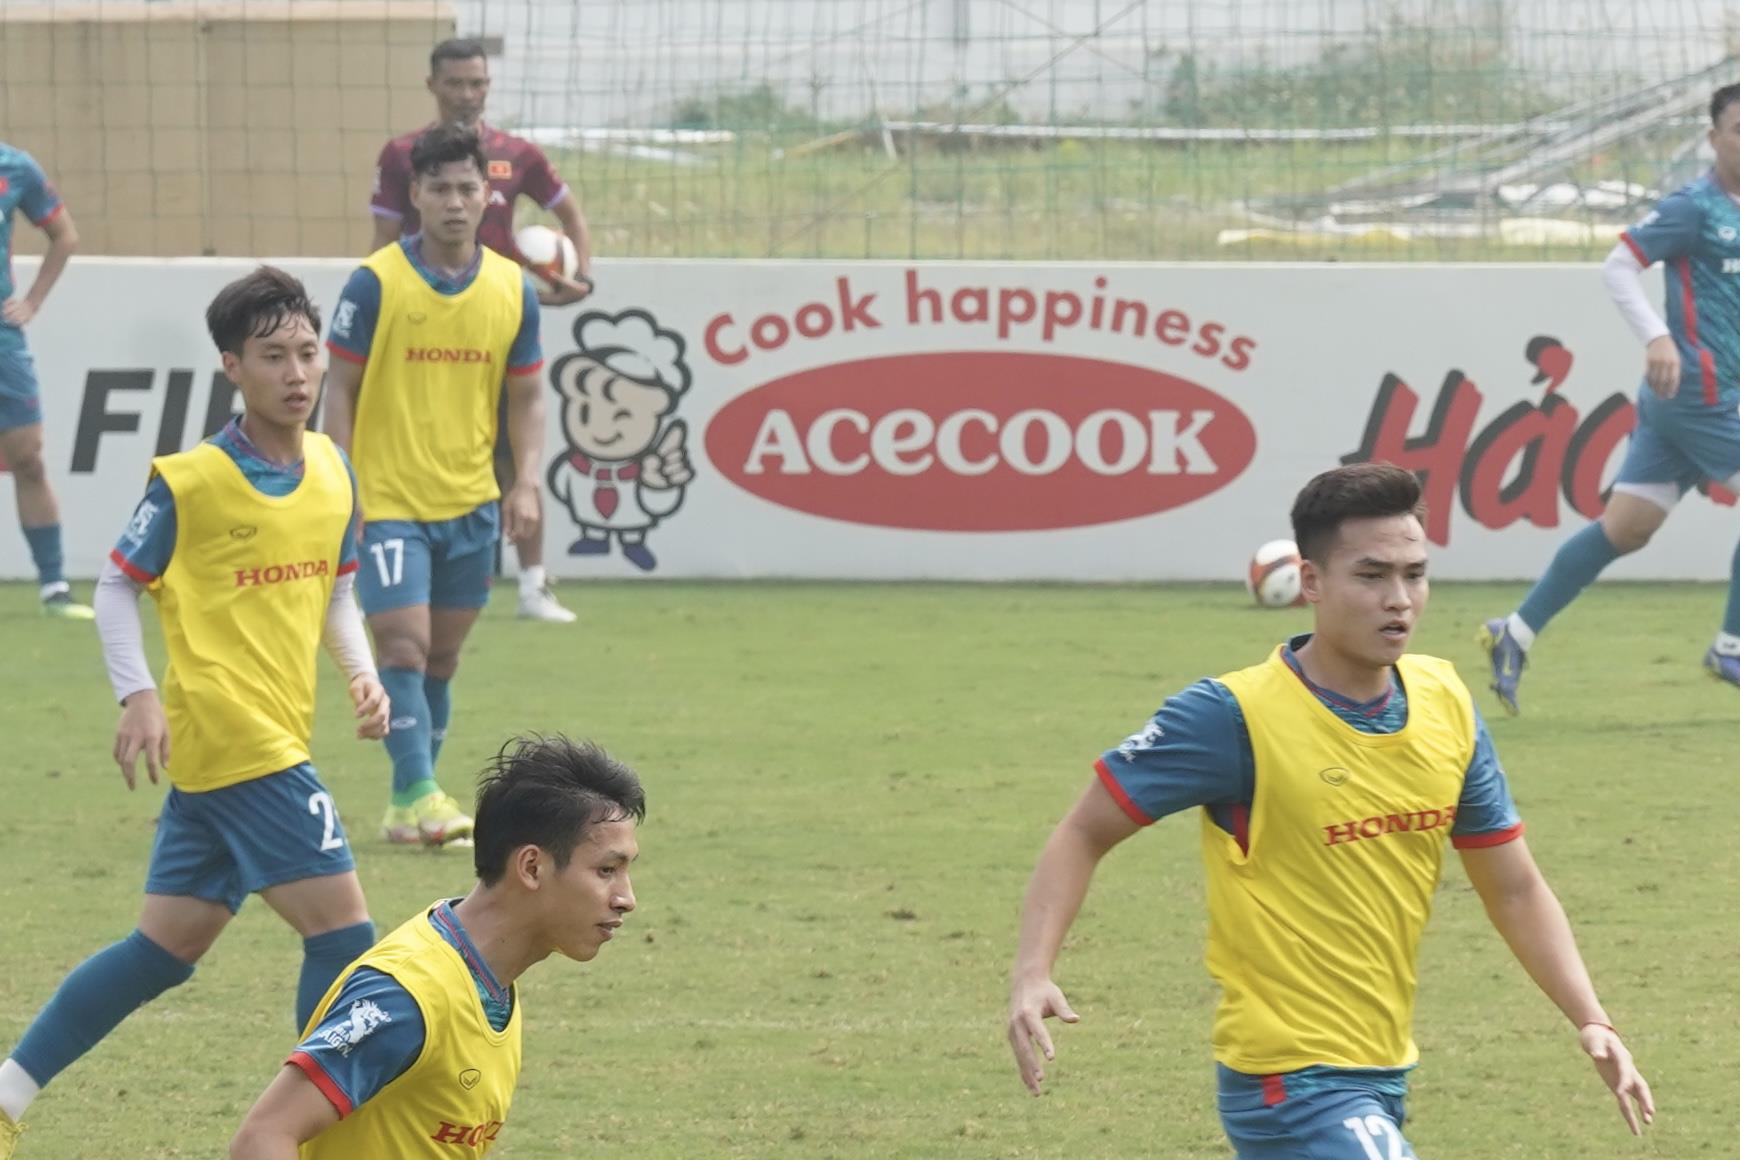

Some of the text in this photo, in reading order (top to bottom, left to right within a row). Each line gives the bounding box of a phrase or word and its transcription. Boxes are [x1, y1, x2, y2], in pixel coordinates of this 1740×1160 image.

[703, 268, 1258, 372] Cook happiness
[234, 559, 329, 588] HONDA
[369, 538, 405, 588] 17
[308, 791, 344, 852] 2
